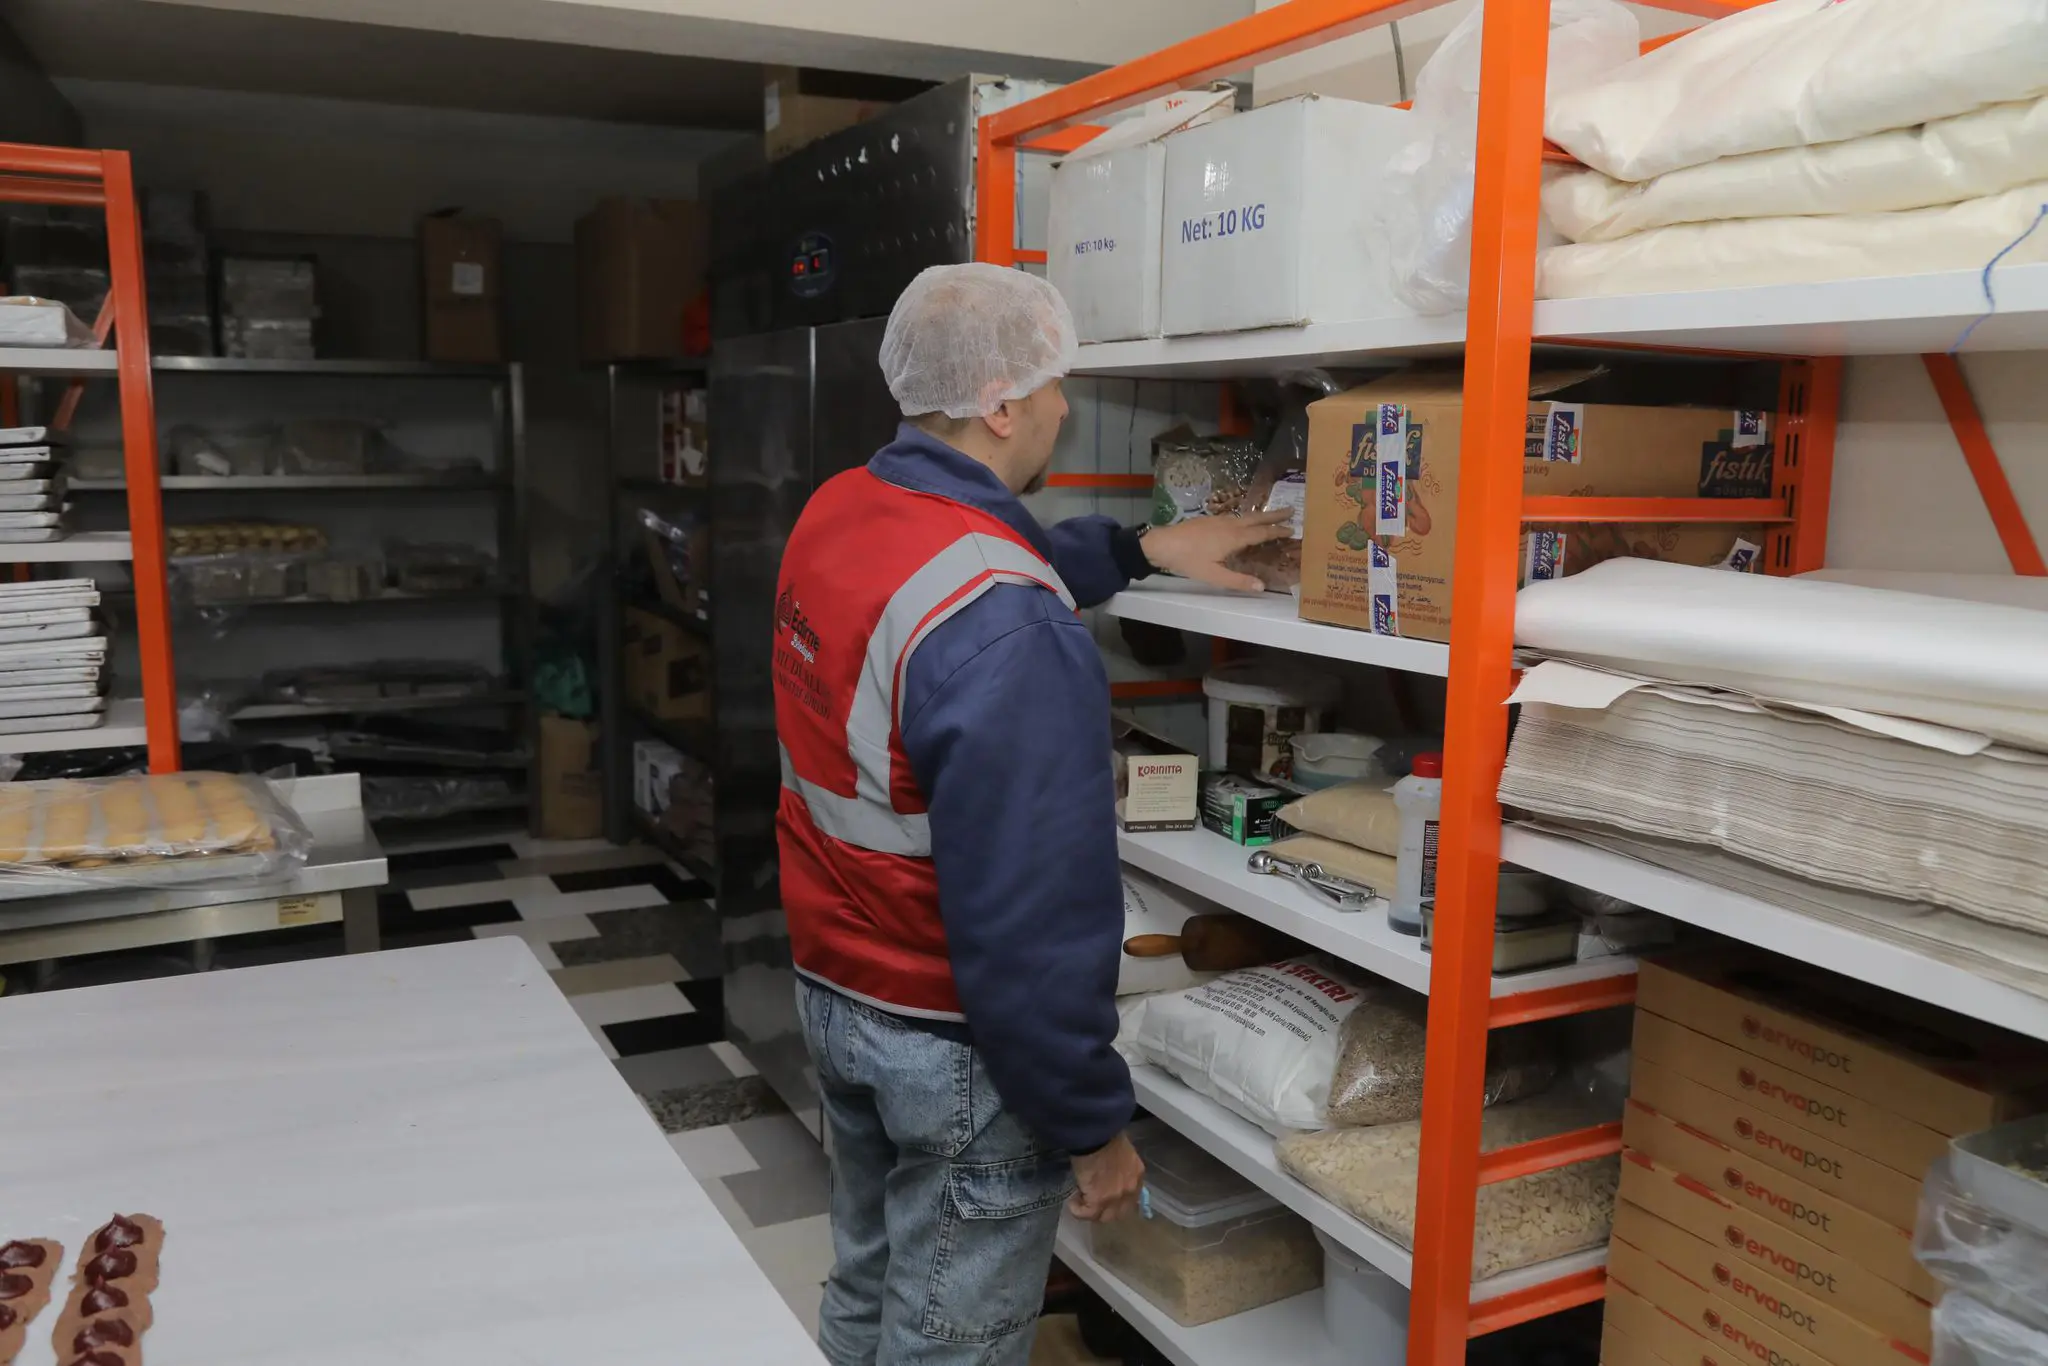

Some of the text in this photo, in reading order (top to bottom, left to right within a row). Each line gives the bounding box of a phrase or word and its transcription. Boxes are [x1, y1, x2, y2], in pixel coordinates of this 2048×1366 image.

[1075, 240, 1092, 255] NET:
[1093, 239, 1103, 252] 10
[1182, 203, 1266, 243] Net: 10 KG
[791, 609, 820, 651] Edirne
[1282, 964, 1358, 1003] ŞEKERİ
[1757, 1080, 1848, 1128] ervapot
[1754, 1130, 1842, 1180] ervapot
[1743, 1181, 1831, 1233] ervapot
[1745, 1239, 1838, 1294] ervapot
[1732, 1277, 1816, 1335] ervapot
